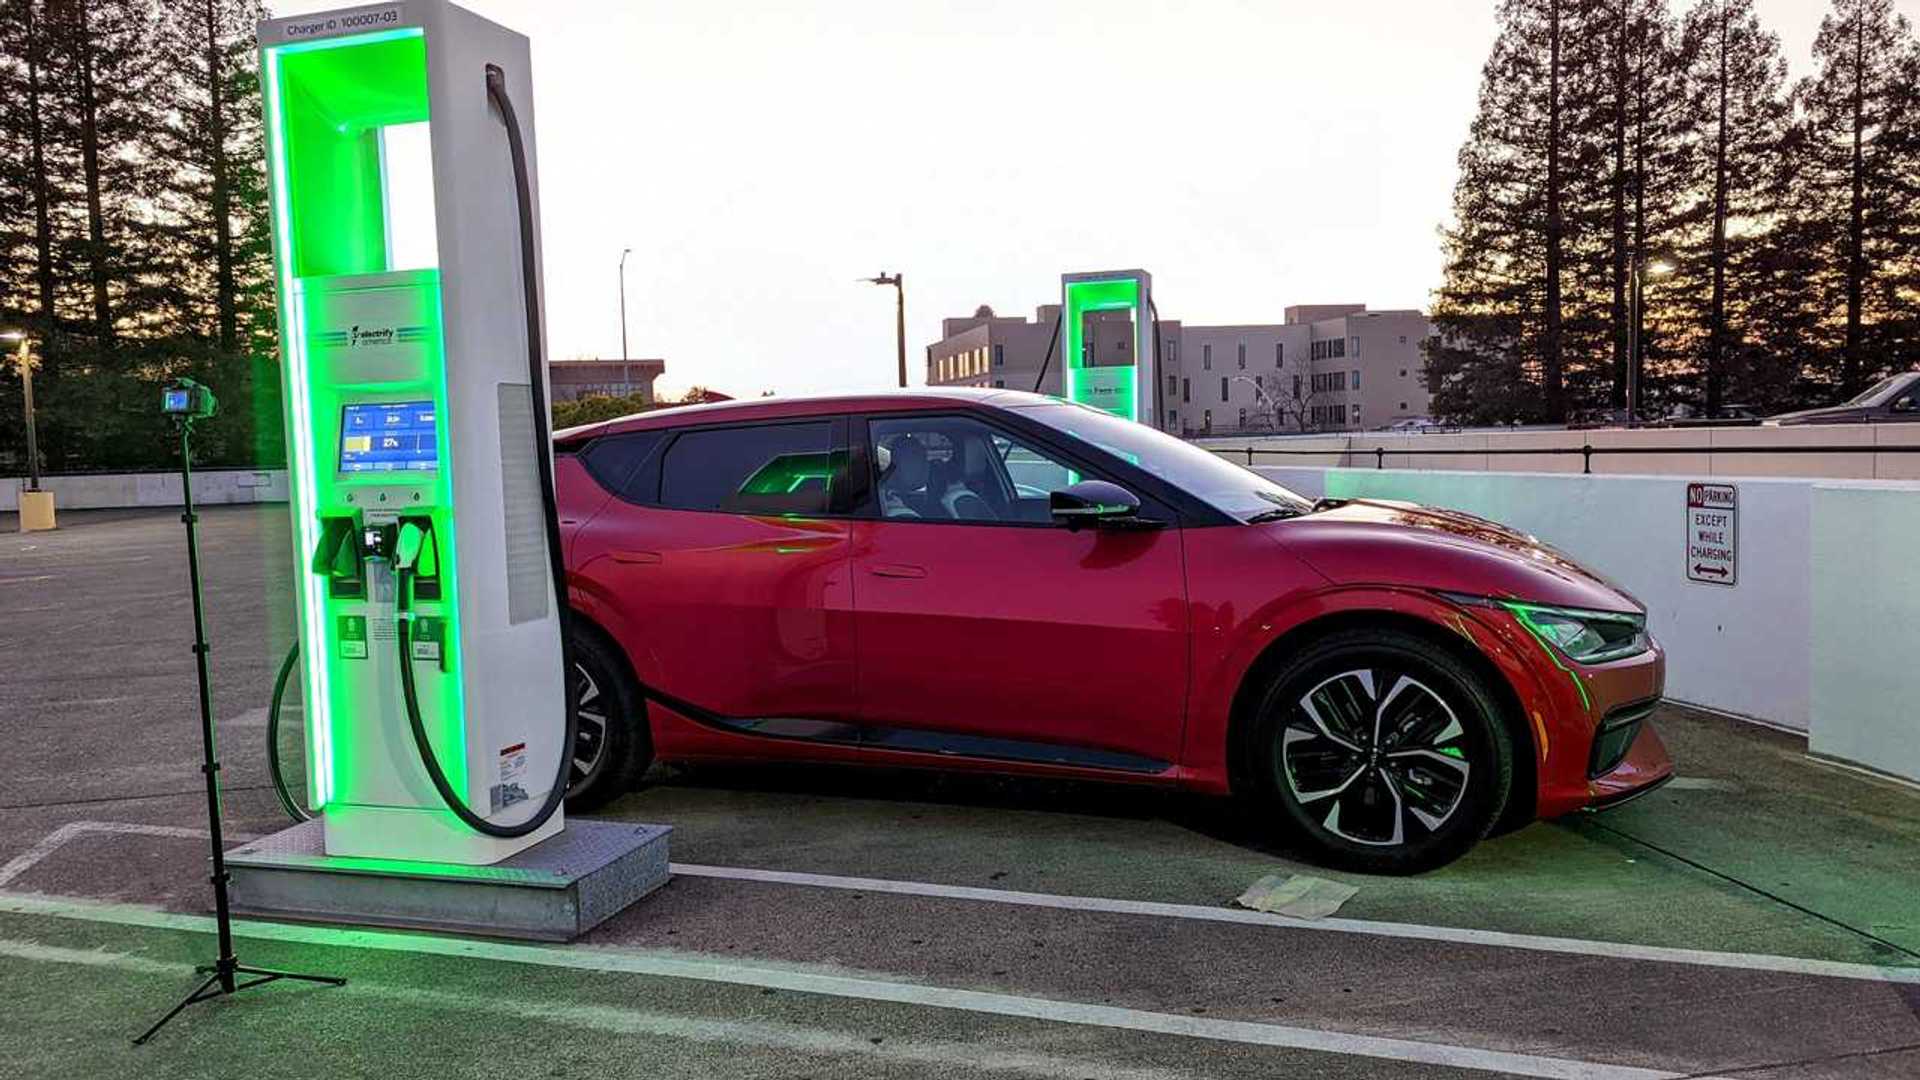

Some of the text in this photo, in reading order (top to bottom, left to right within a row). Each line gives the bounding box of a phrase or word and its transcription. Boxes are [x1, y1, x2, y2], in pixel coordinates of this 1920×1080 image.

[287, 11, 398, 36] Charger ID 100007-03
[361, 327, 393, 338] electrify
[1689, 486, 1733, 505] NO PARKING
[1695, 514, 1727, 528] EXCEPT
[1698, 530, 1725, 545] WHILE
[1691, 545, 1732, 562] CHARGING
